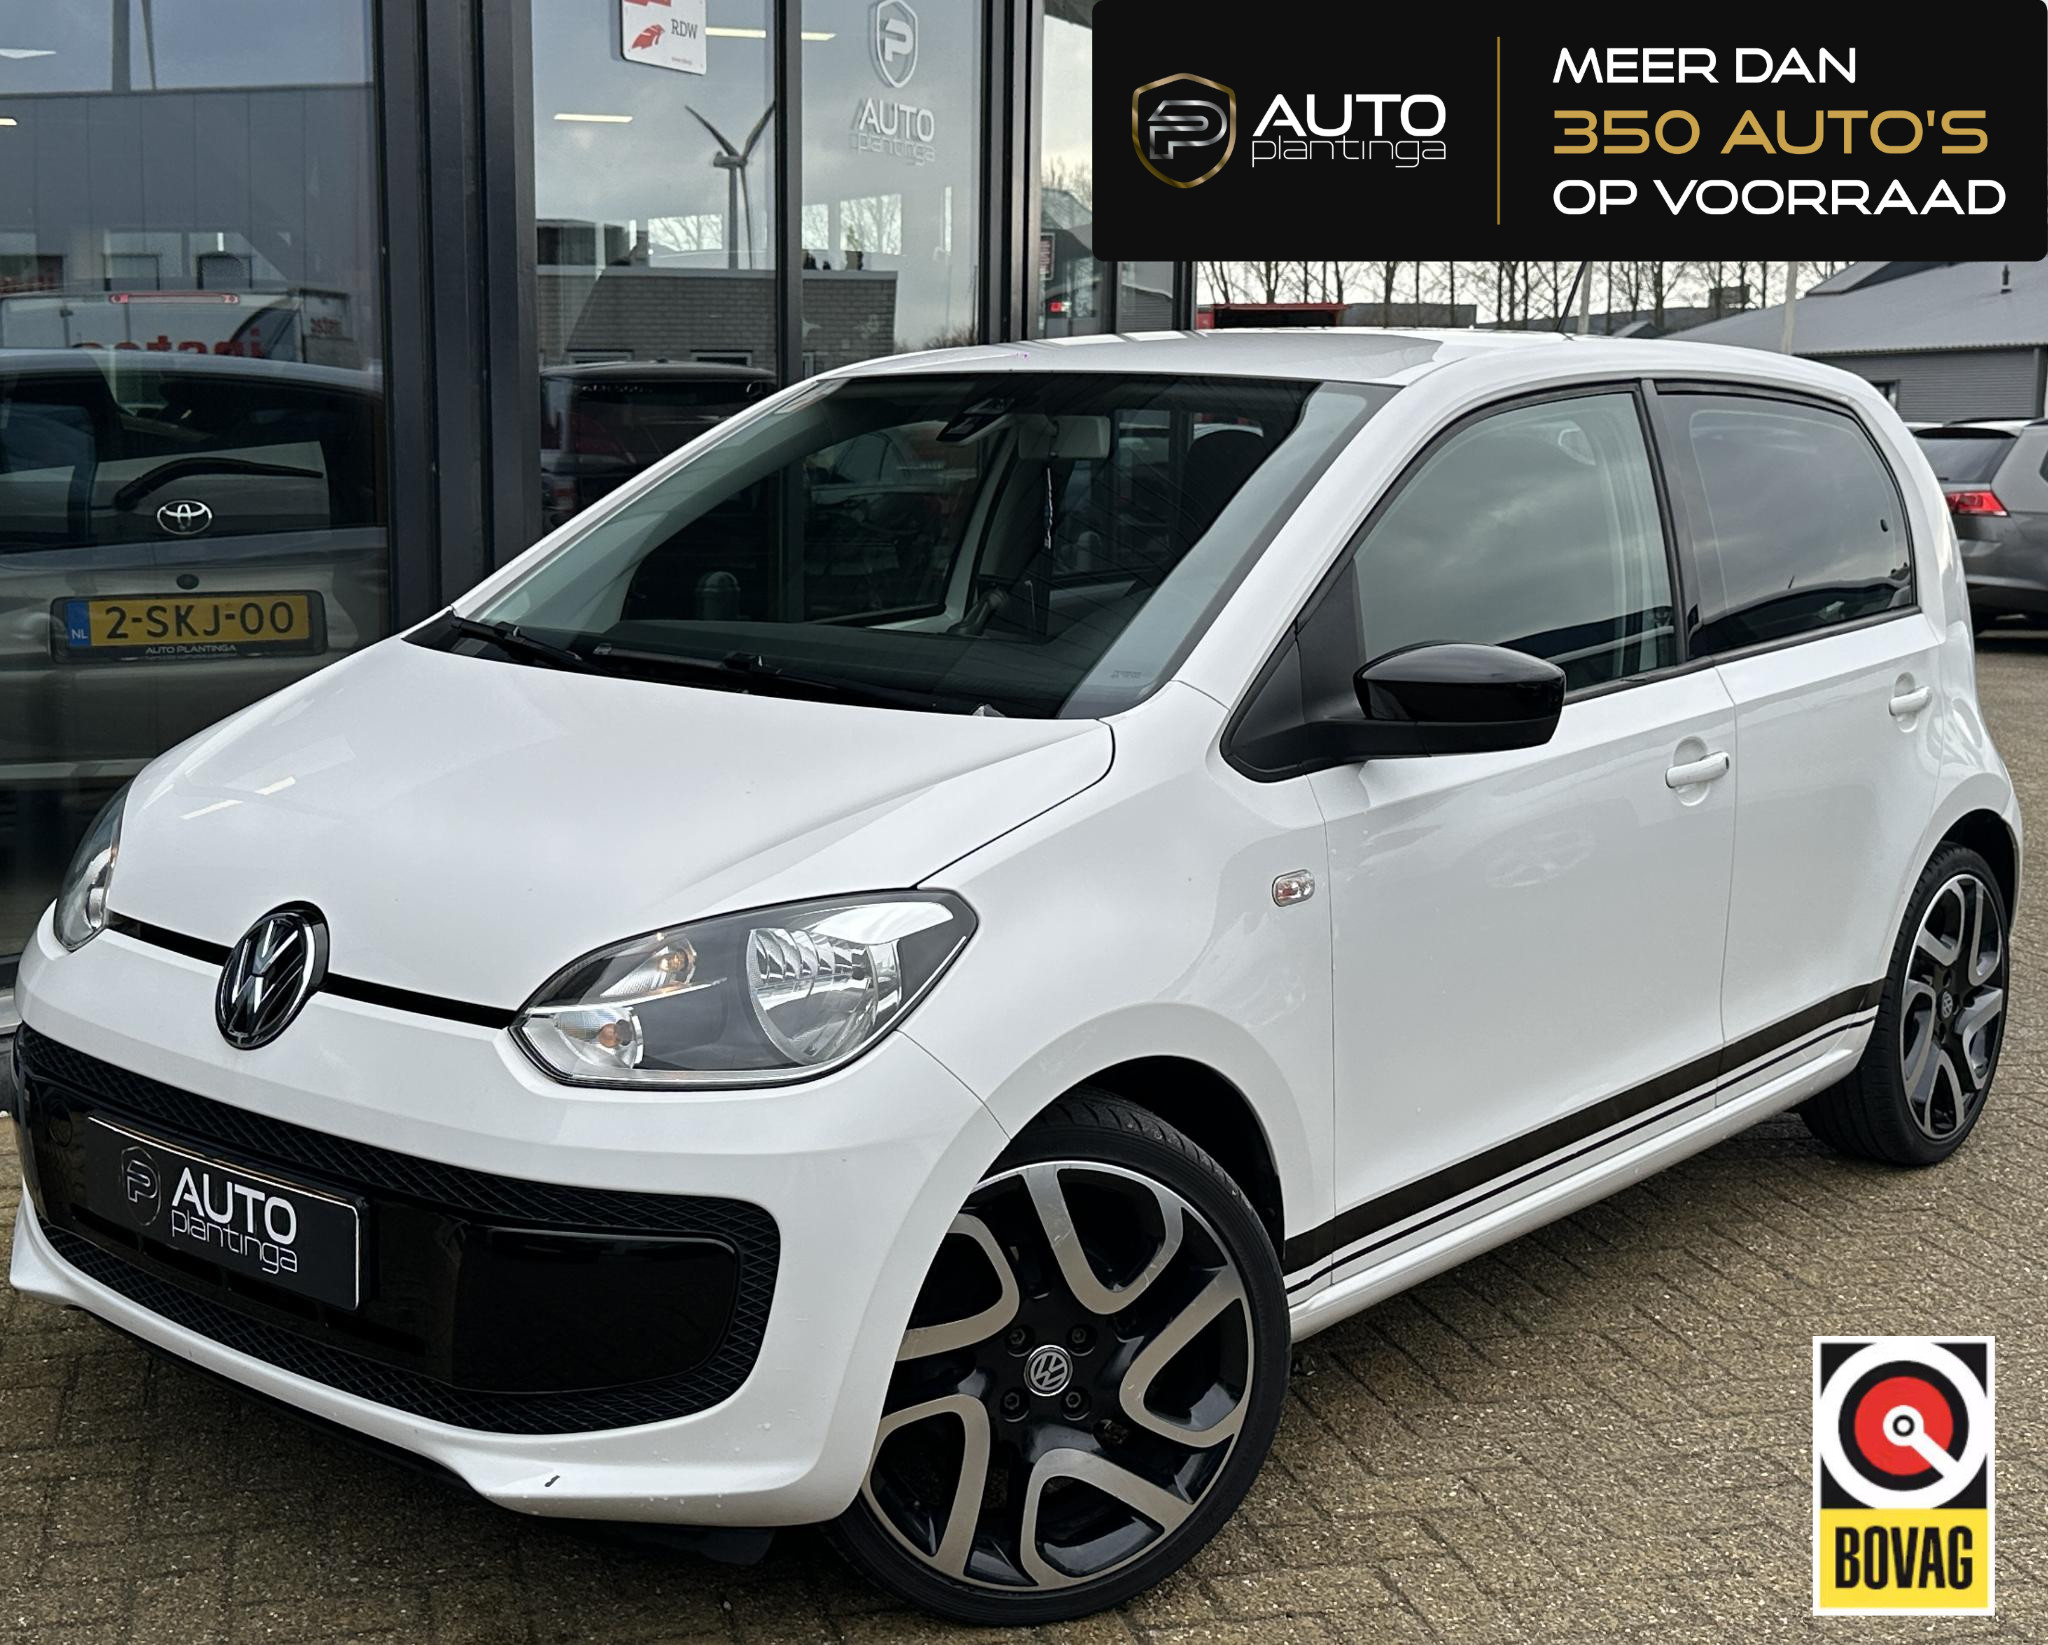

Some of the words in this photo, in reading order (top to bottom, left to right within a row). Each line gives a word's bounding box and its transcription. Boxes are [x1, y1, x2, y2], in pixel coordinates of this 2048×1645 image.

[671, 18, 698, 40] RDW
[859, 97, 935, 142] AUTO
[71, 628, 88, 639] NL
[105, 602, 294, 639] 2-SKJ-00
[145, 646, 175, 654] AUTO
[176, 644, 236, 654] PLANTINGA
[171, 1167, 297, 1245] AUTO
[171, 1209, 297, 1274] plantinga
